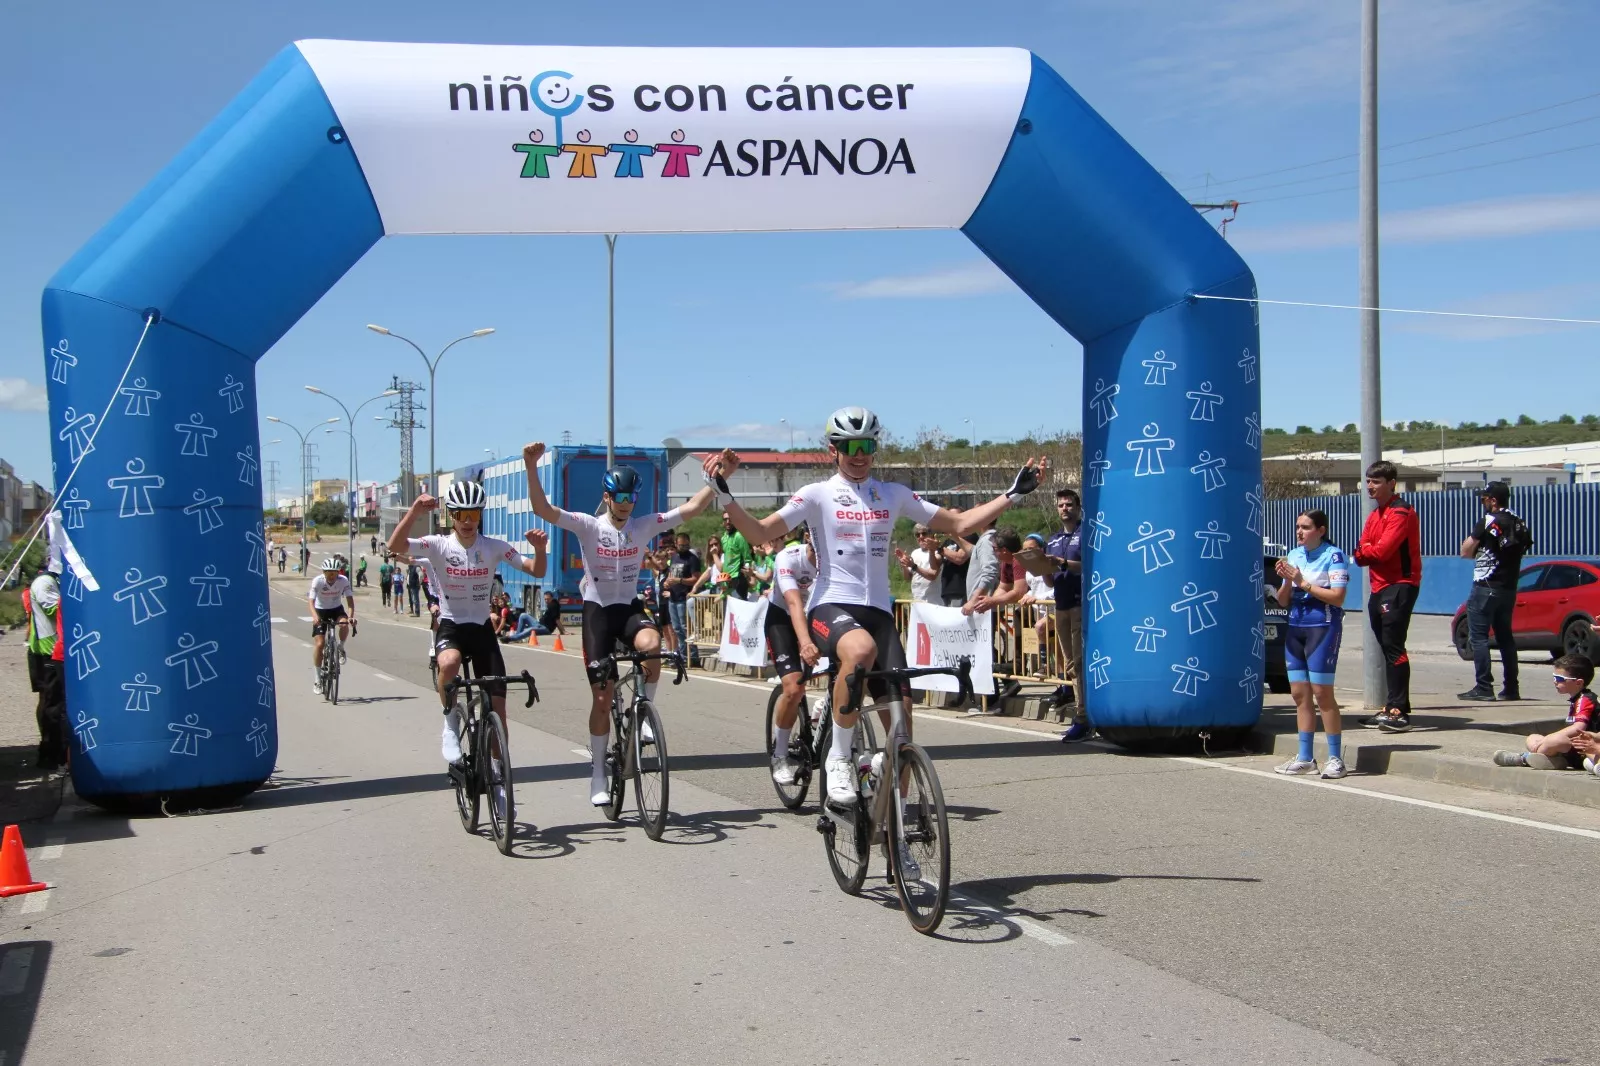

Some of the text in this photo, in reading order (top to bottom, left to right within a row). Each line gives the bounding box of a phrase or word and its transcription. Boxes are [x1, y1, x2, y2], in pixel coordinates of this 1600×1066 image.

[633, 83, 727, 112] con
[745, 75, 915, 111] cáncer
[702, 137, 917, 178] ASPANOA
[836, 508, 890, 521] ecotisa
[597, 546, 639, 557] ecotisa
[446, 566, 489, 577] ecotisa
[943, 648, 976, 669] Huea
